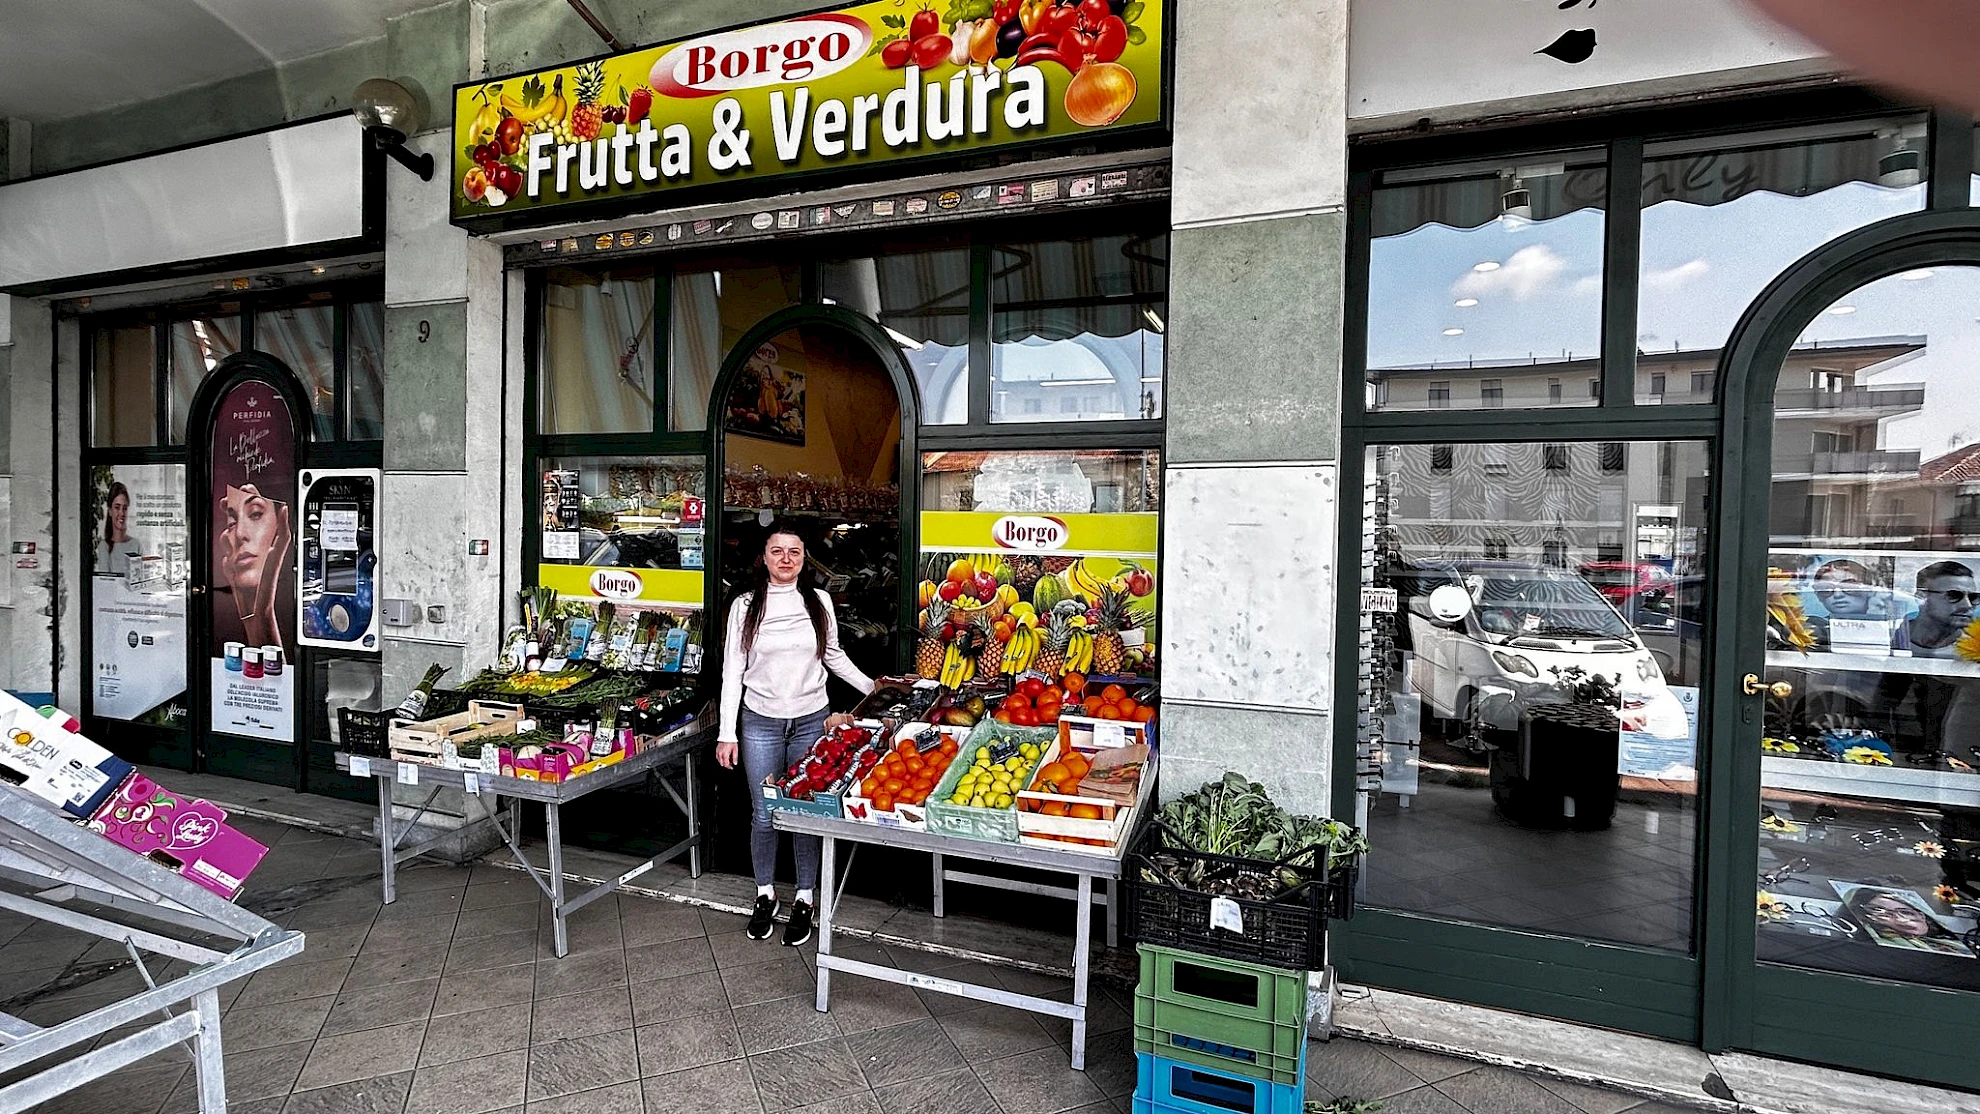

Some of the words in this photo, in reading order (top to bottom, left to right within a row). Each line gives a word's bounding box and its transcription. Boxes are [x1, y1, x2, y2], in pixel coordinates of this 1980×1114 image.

[685, 30, 851, 87] Borgo
[526, 118, 692, 197] Frutta
[707, 97, 752, 172] &
[769, 62, 1045, 161] Verdura
[418, 320, 430, 342] 9
[233, 411, 271, 419] PERFIDIA
[1005, 520, 1058, 547] Borgo
[598, 573, 636, 596] Borgo
[175, 829, 209, 845] Lady
[178, 818, 212, 834] Pink
